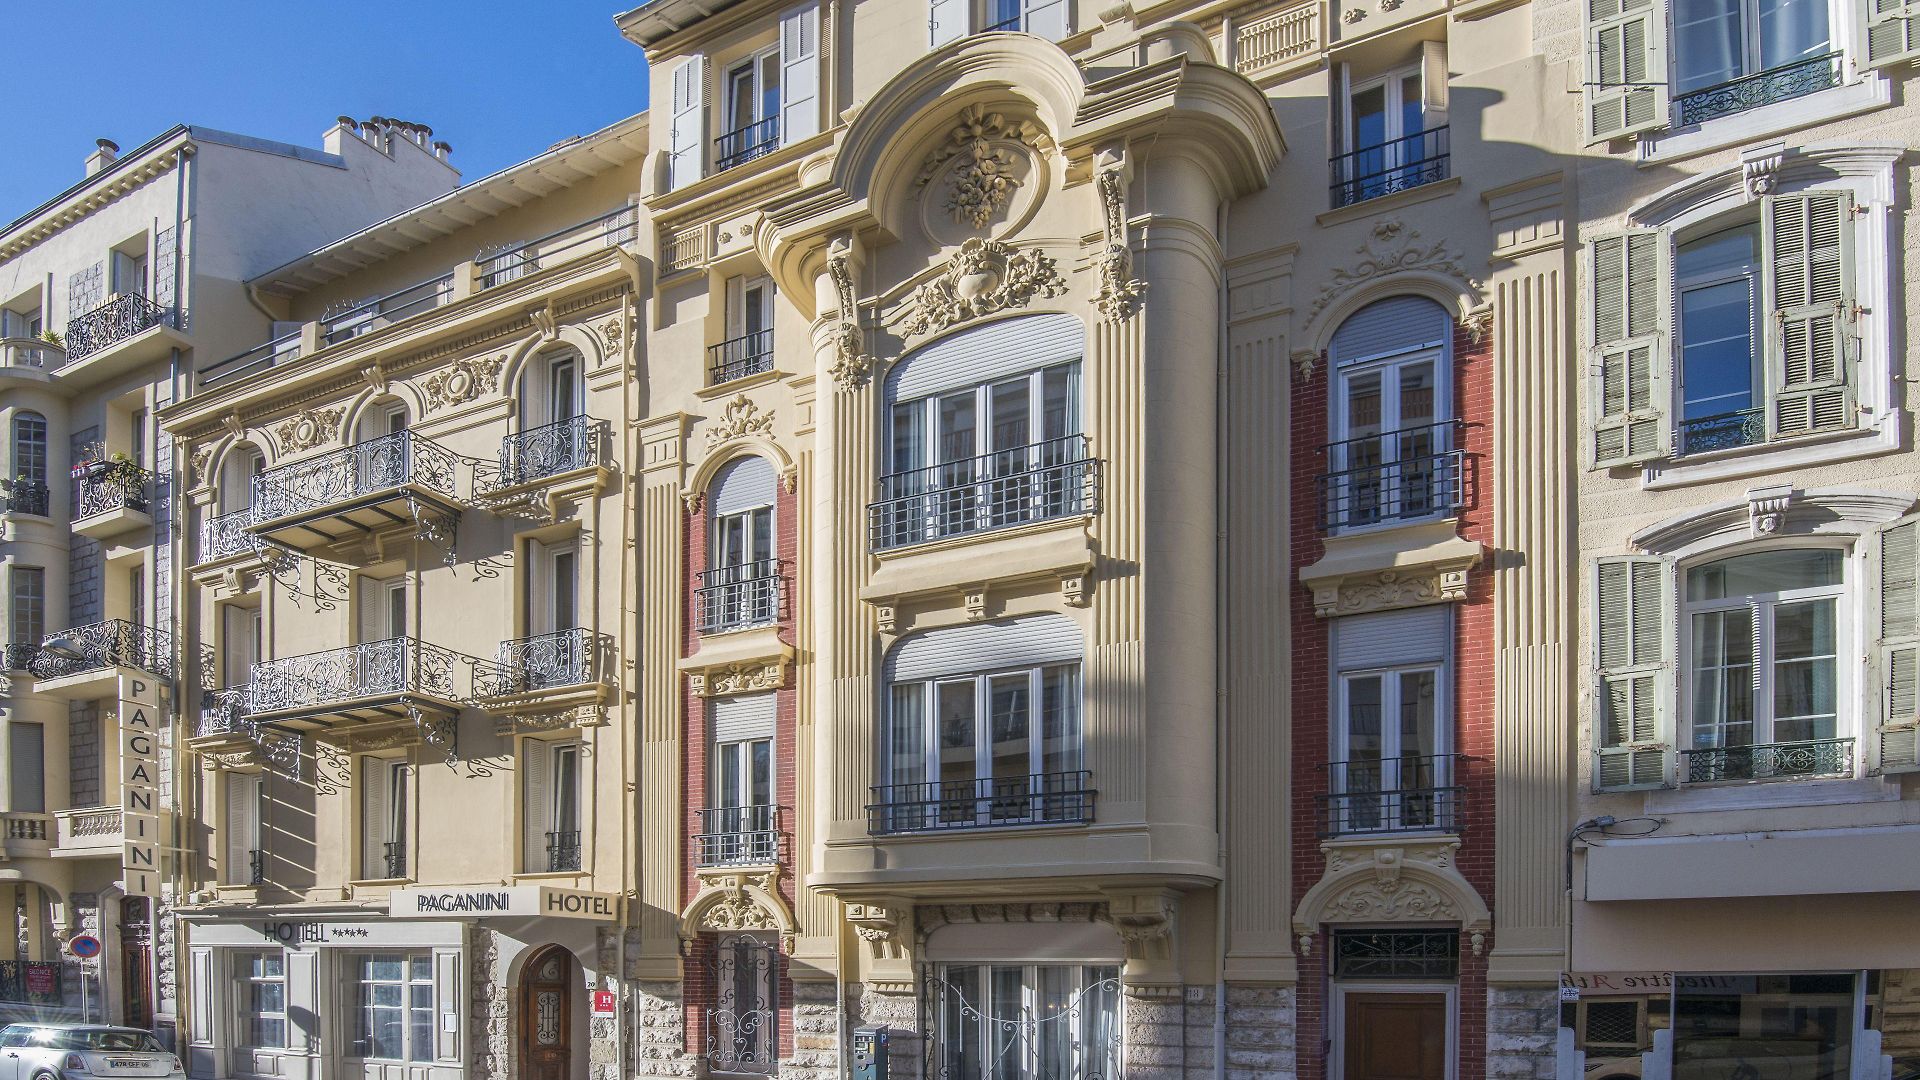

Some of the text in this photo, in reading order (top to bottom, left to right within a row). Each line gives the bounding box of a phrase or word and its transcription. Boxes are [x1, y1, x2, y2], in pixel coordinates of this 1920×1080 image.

[130, 679, 152, 892] PAGANINI
[417, 892, 613, 915] PAGANINI HOTEL
[264, 922, 329, 943] HOTEL
[602, 995, 611, 1003] H
[881, 1034, 887, 1043] P
